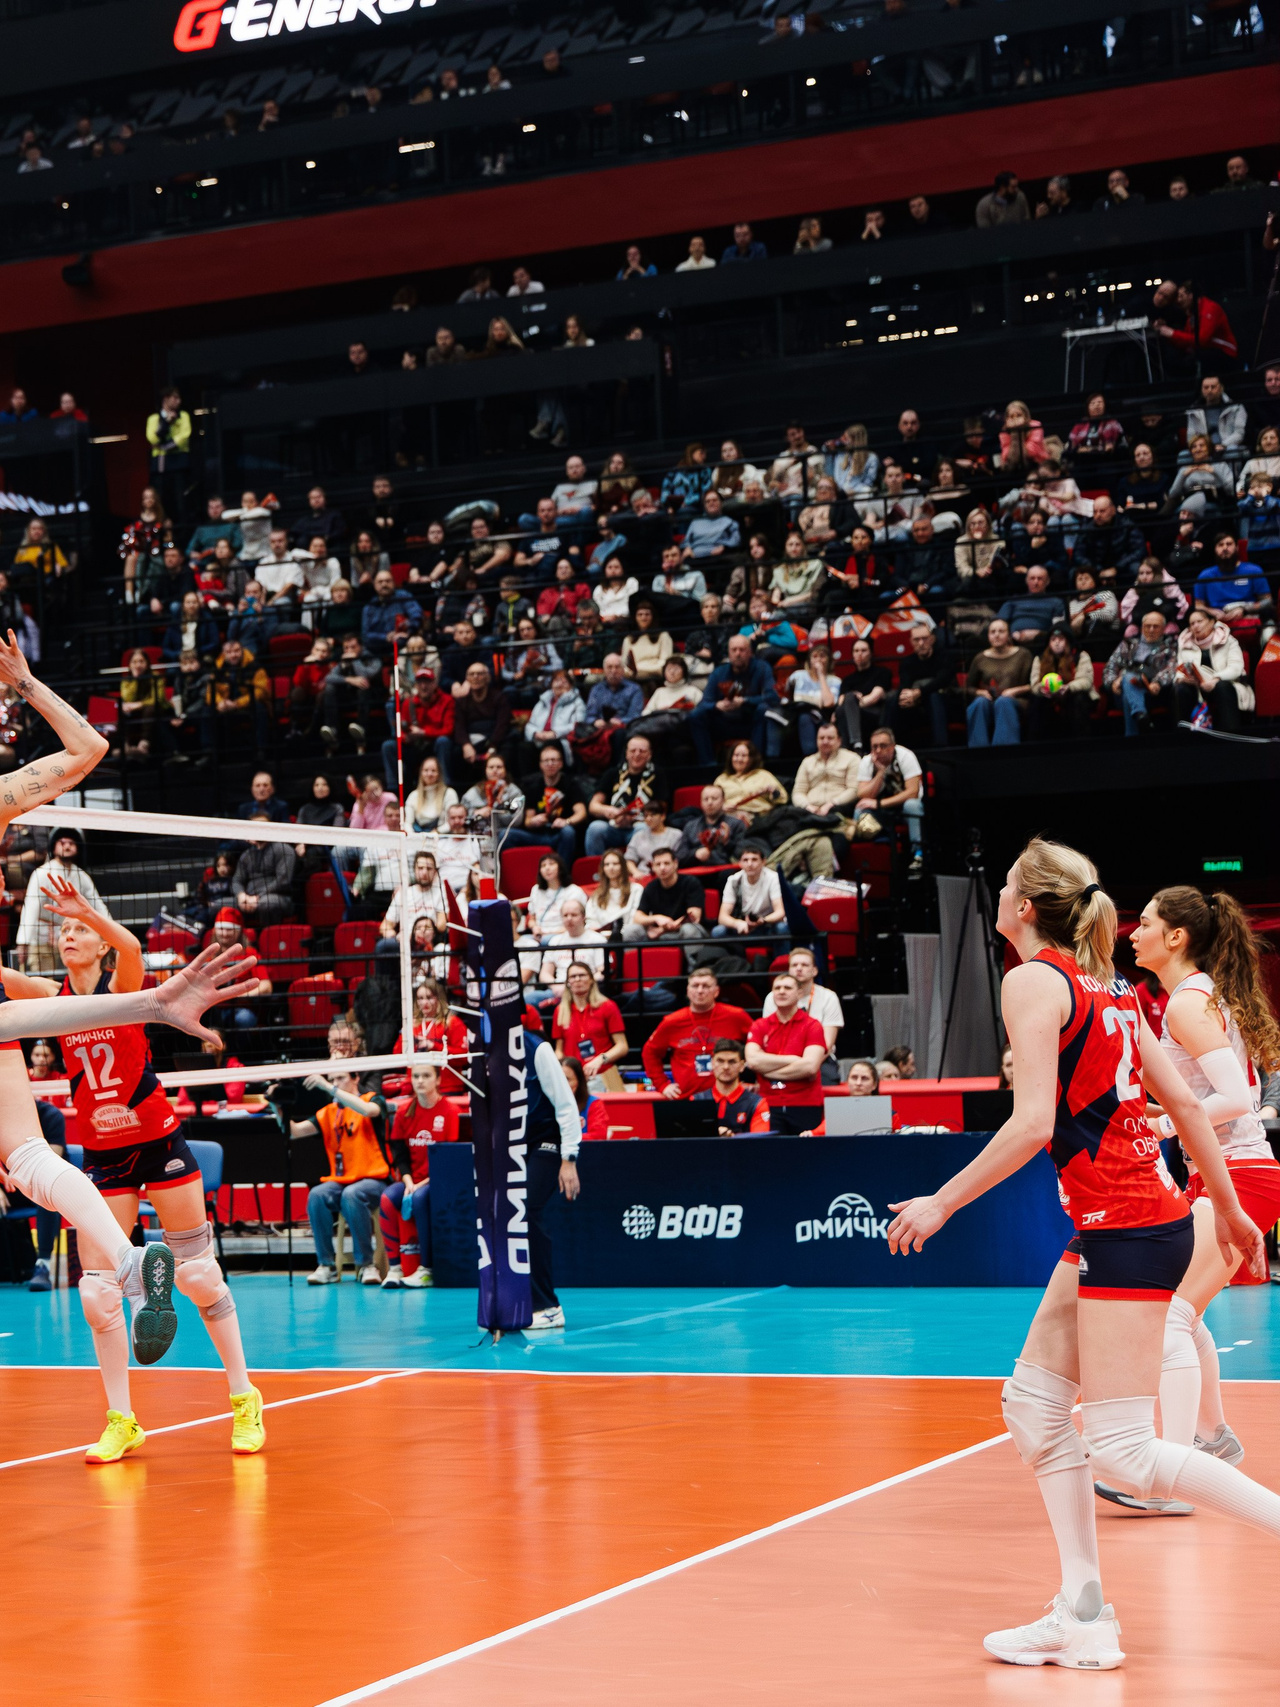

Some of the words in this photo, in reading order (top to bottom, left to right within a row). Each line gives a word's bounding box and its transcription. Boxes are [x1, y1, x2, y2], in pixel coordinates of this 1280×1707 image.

[173, 0, 437, 52] G-ENER
[65, 1028, 115, 1047] ОМИЧКА
[73, 1043, 124, 1091] 12
[507, 1025, 531, 1275] ОМИЧКА
[657, 1204, 743, 1239] ВФВ
[795, 1217, 889, 1243] ОМИЧК
